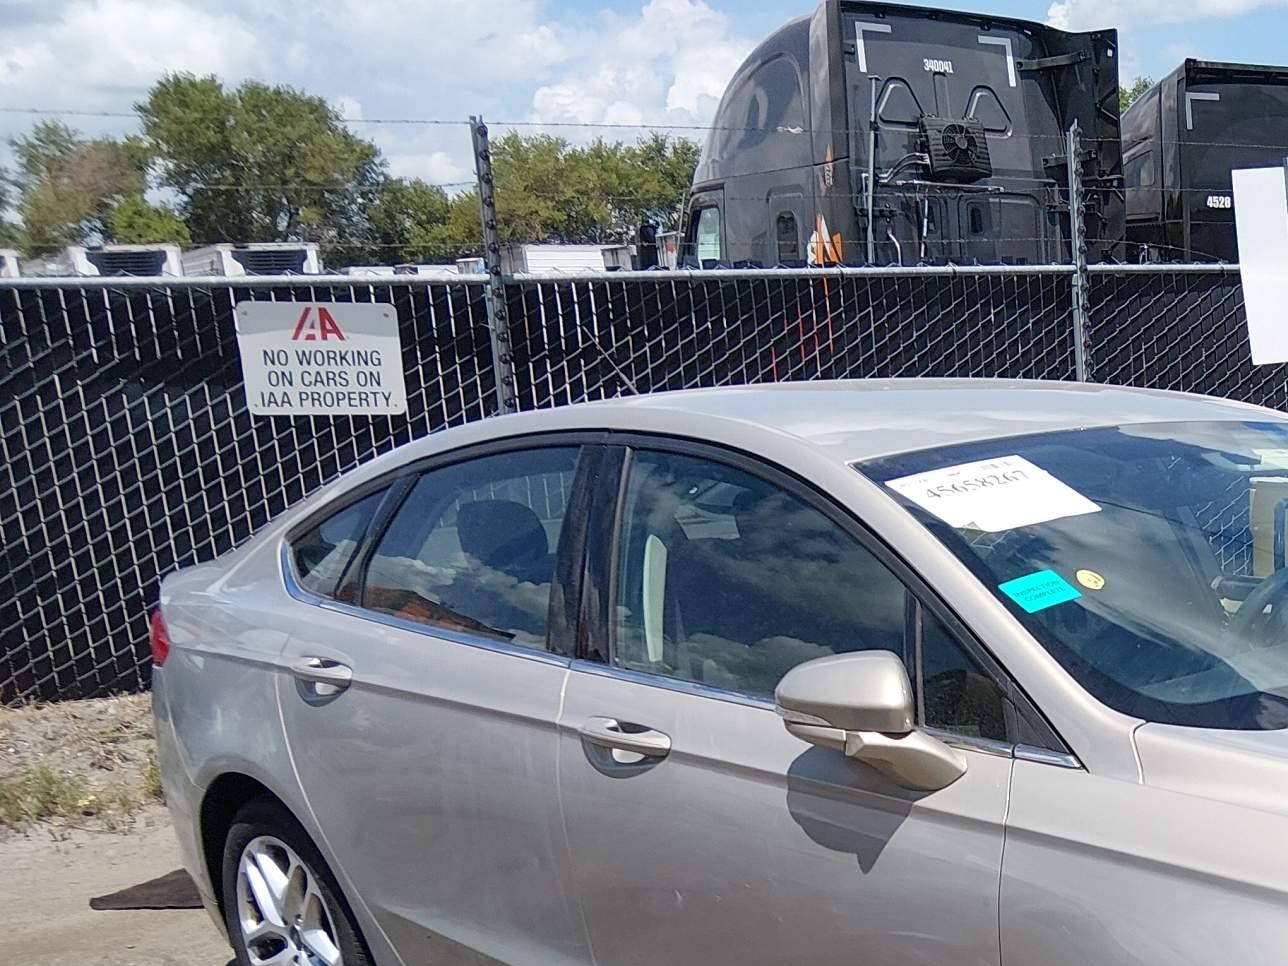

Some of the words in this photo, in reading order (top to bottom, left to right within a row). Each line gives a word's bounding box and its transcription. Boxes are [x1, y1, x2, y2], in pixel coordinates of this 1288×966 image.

[1207, 195, 1231, 209] 4528
[263, 350, 289, 366] NO
[295, 350, 382, 367] WORKING
[268, 371, 293, 387] ON
[301, 371, 349, 387] CARS
[356, 371, 381, 387] ON
[261, 391, 292, 408] IAA
[299, 391, 392, 408] PROPERTY
